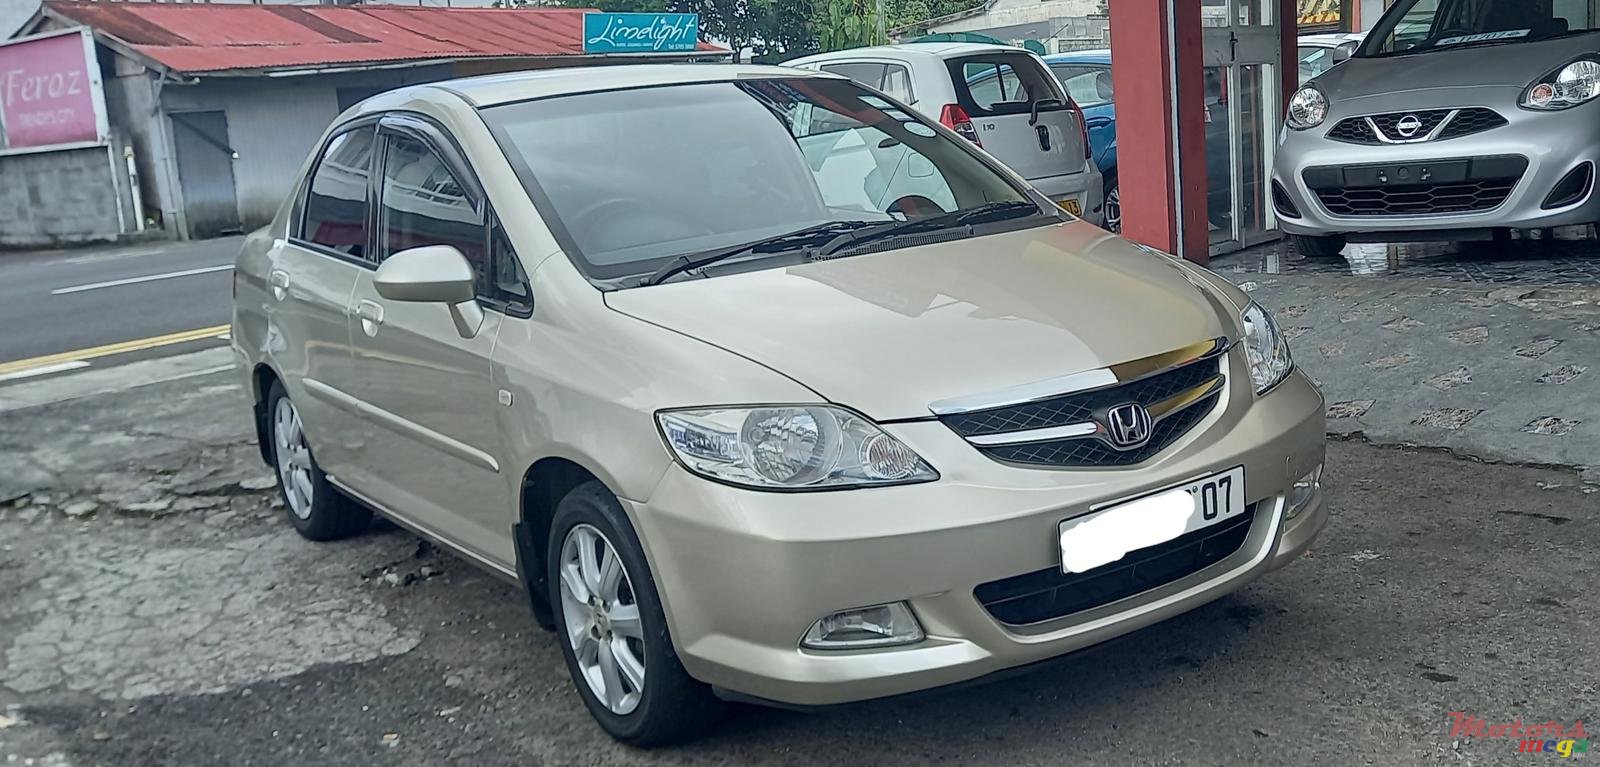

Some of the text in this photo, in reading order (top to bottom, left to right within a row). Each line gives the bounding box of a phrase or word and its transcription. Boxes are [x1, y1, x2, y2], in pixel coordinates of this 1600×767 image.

[588, 16, 695, 50] Limelight
[7, 69, 81, 107] Feroz
[1202, 475, 1231, 521] 07
